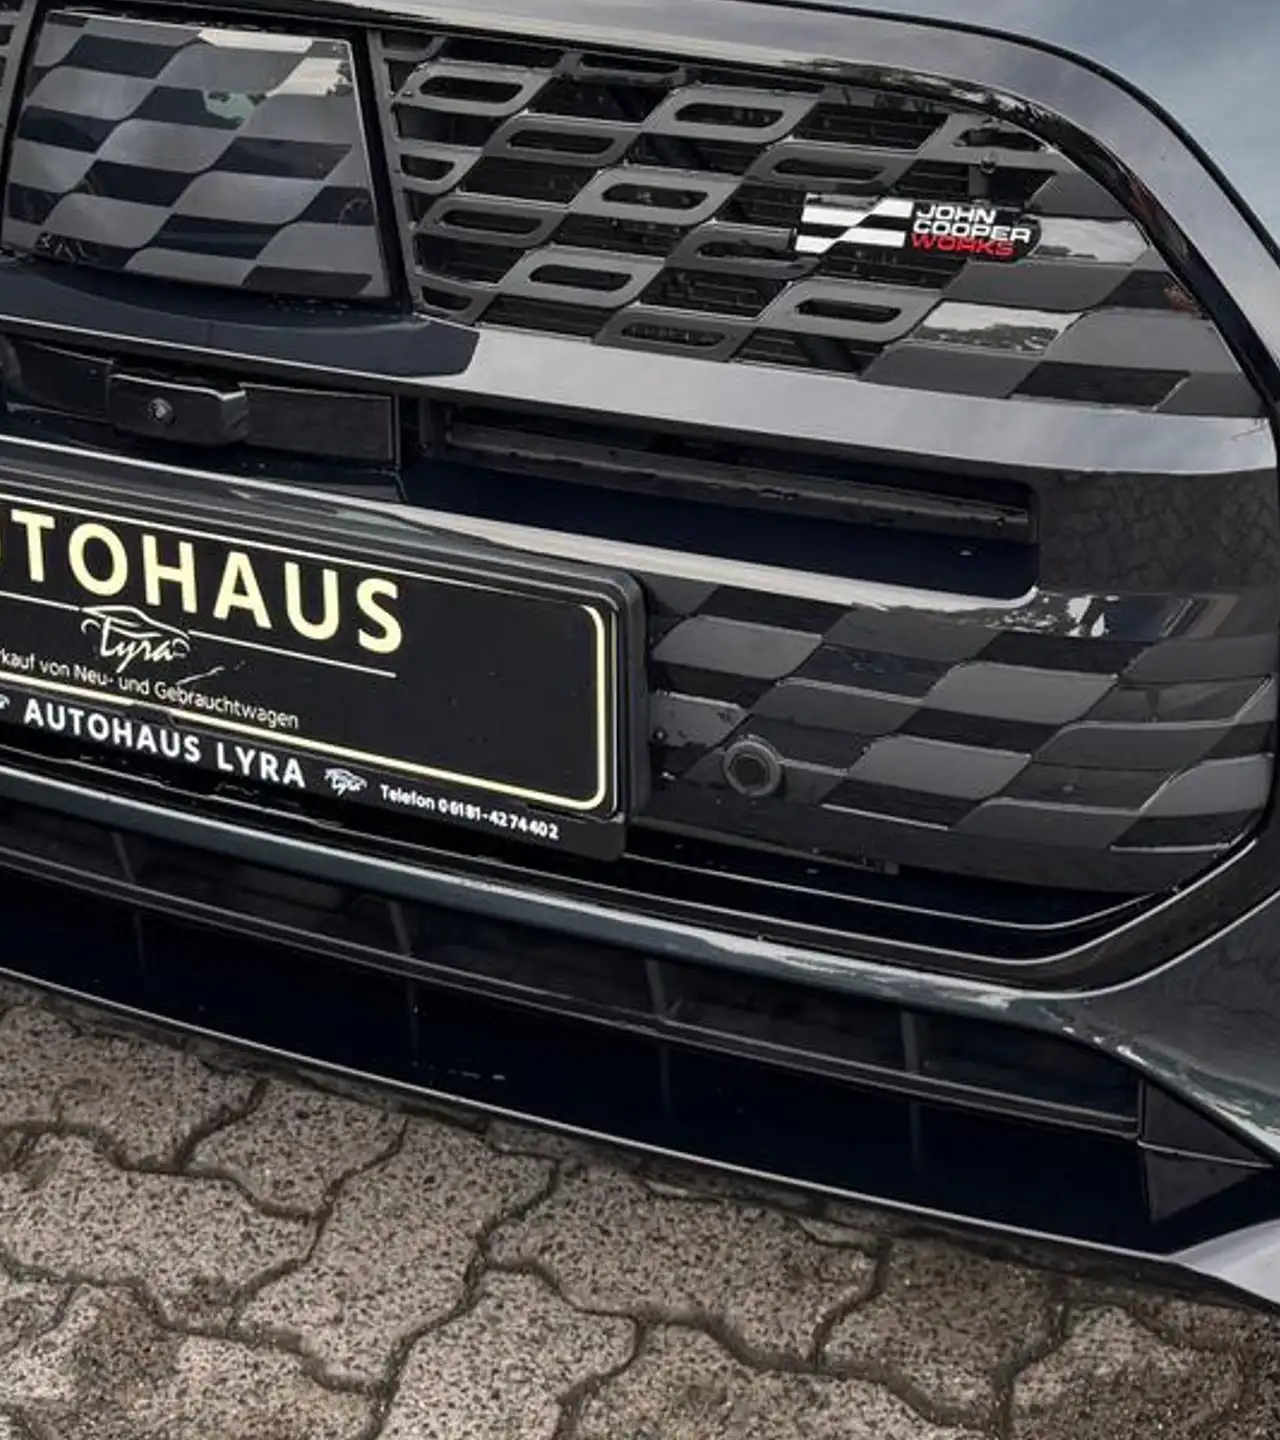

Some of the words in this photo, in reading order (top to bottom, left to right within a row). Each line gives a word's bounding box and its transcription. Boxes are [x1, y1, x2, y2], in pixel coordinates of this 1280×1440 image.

[912, 217, 1032, 245] COOPER
[915, 203, 996, 225] JOHN
[911, 234, 1015, 256] WORKS
[94, 613, 182, 674] Lyra
[40, 658, 71, 677] von
[73, 663, 114, 687] Neu-
[117, 673, 150, 696] und
[153, 680, 299, 729] Gebrauchtwagen
[23, 697, 202, 763] AUTOHAUS
[217, 742, 307, 788] LYRA
[379, 783, 436, 811] Telefon
